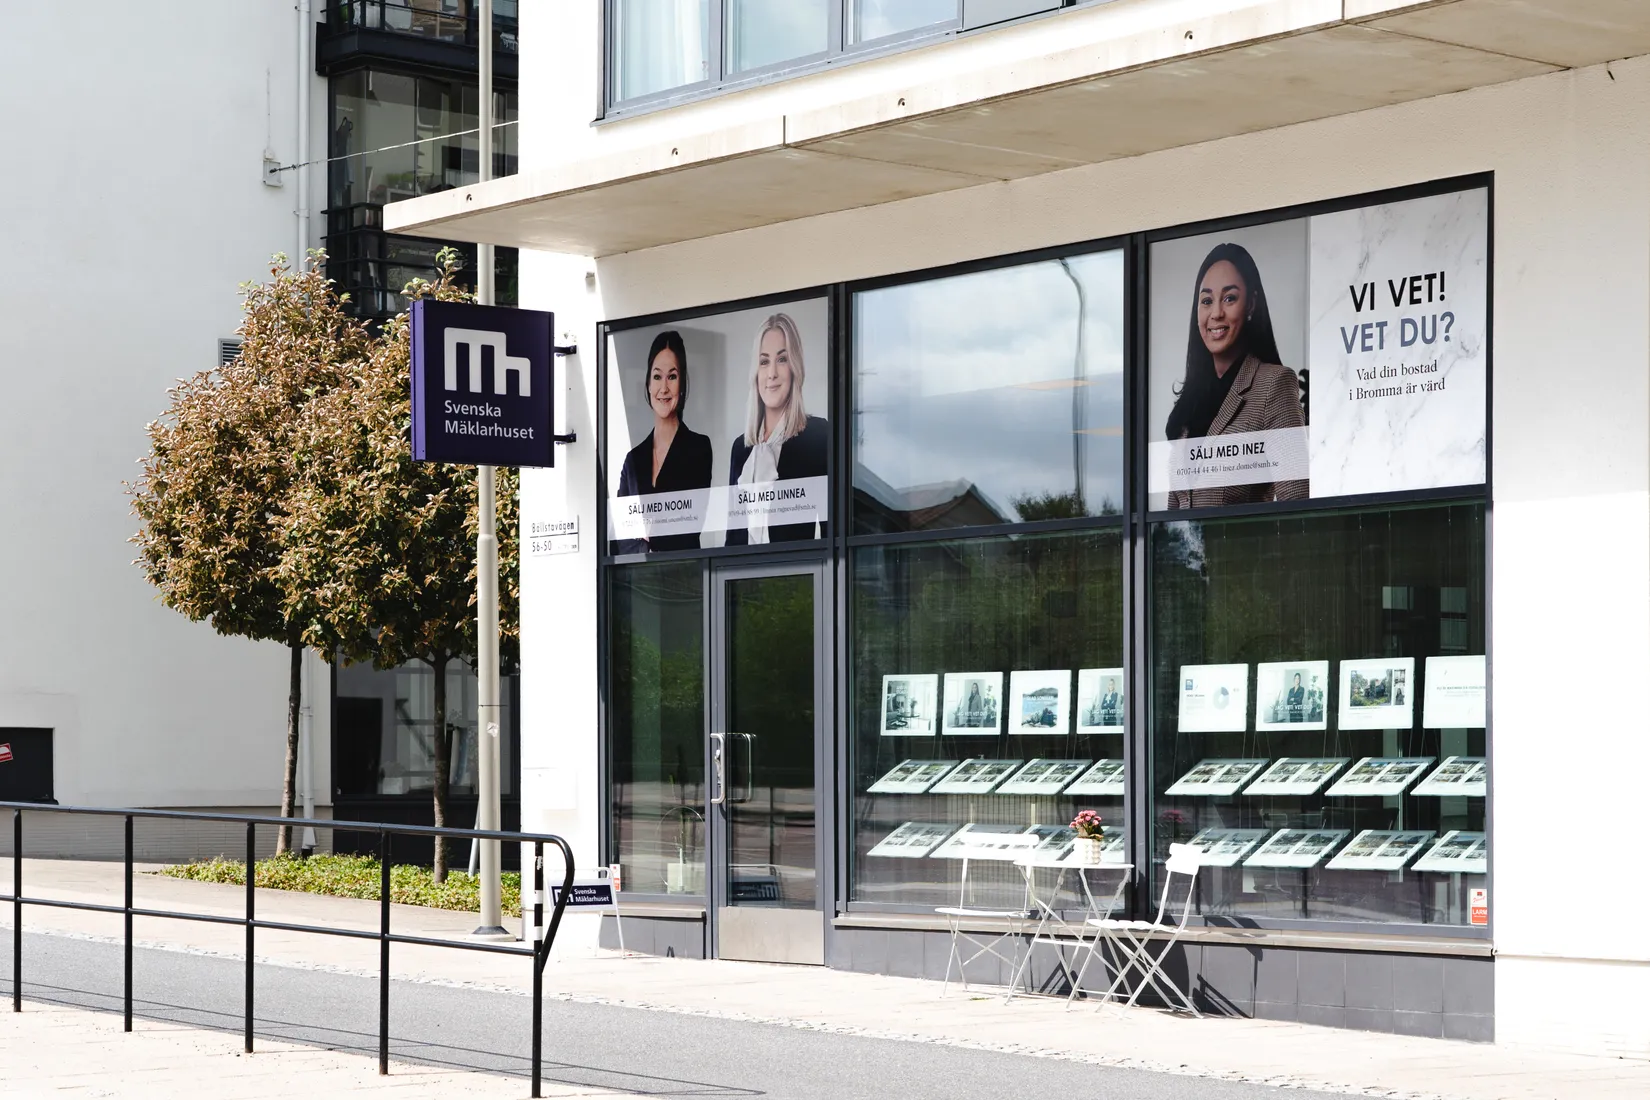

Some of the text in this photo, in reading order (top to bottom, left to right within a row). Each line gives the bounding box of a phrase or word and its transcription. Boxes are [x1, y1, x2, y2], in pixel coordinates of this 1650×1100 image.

[1349, 271, 1445, 313] VI VET!
[1340, 311, 1455, 354] VET DU?
[1356, 359, 1438, 381] Vad din bostad
[1349, 377, 1446, 401] i Bromma är värd
[444, 400, 502, 417] Svenska
[445, 420, 534, 440] Mäklarhuset
[1190, 441, 1265, 461] SÄLJ MED INEZ
[738, 488, 806, 504] SÄLJ MED LINNEA
[628, 499, 692, 515] SÄLJ MED NOOMI
[532, 540, 552, 553] 56-50
